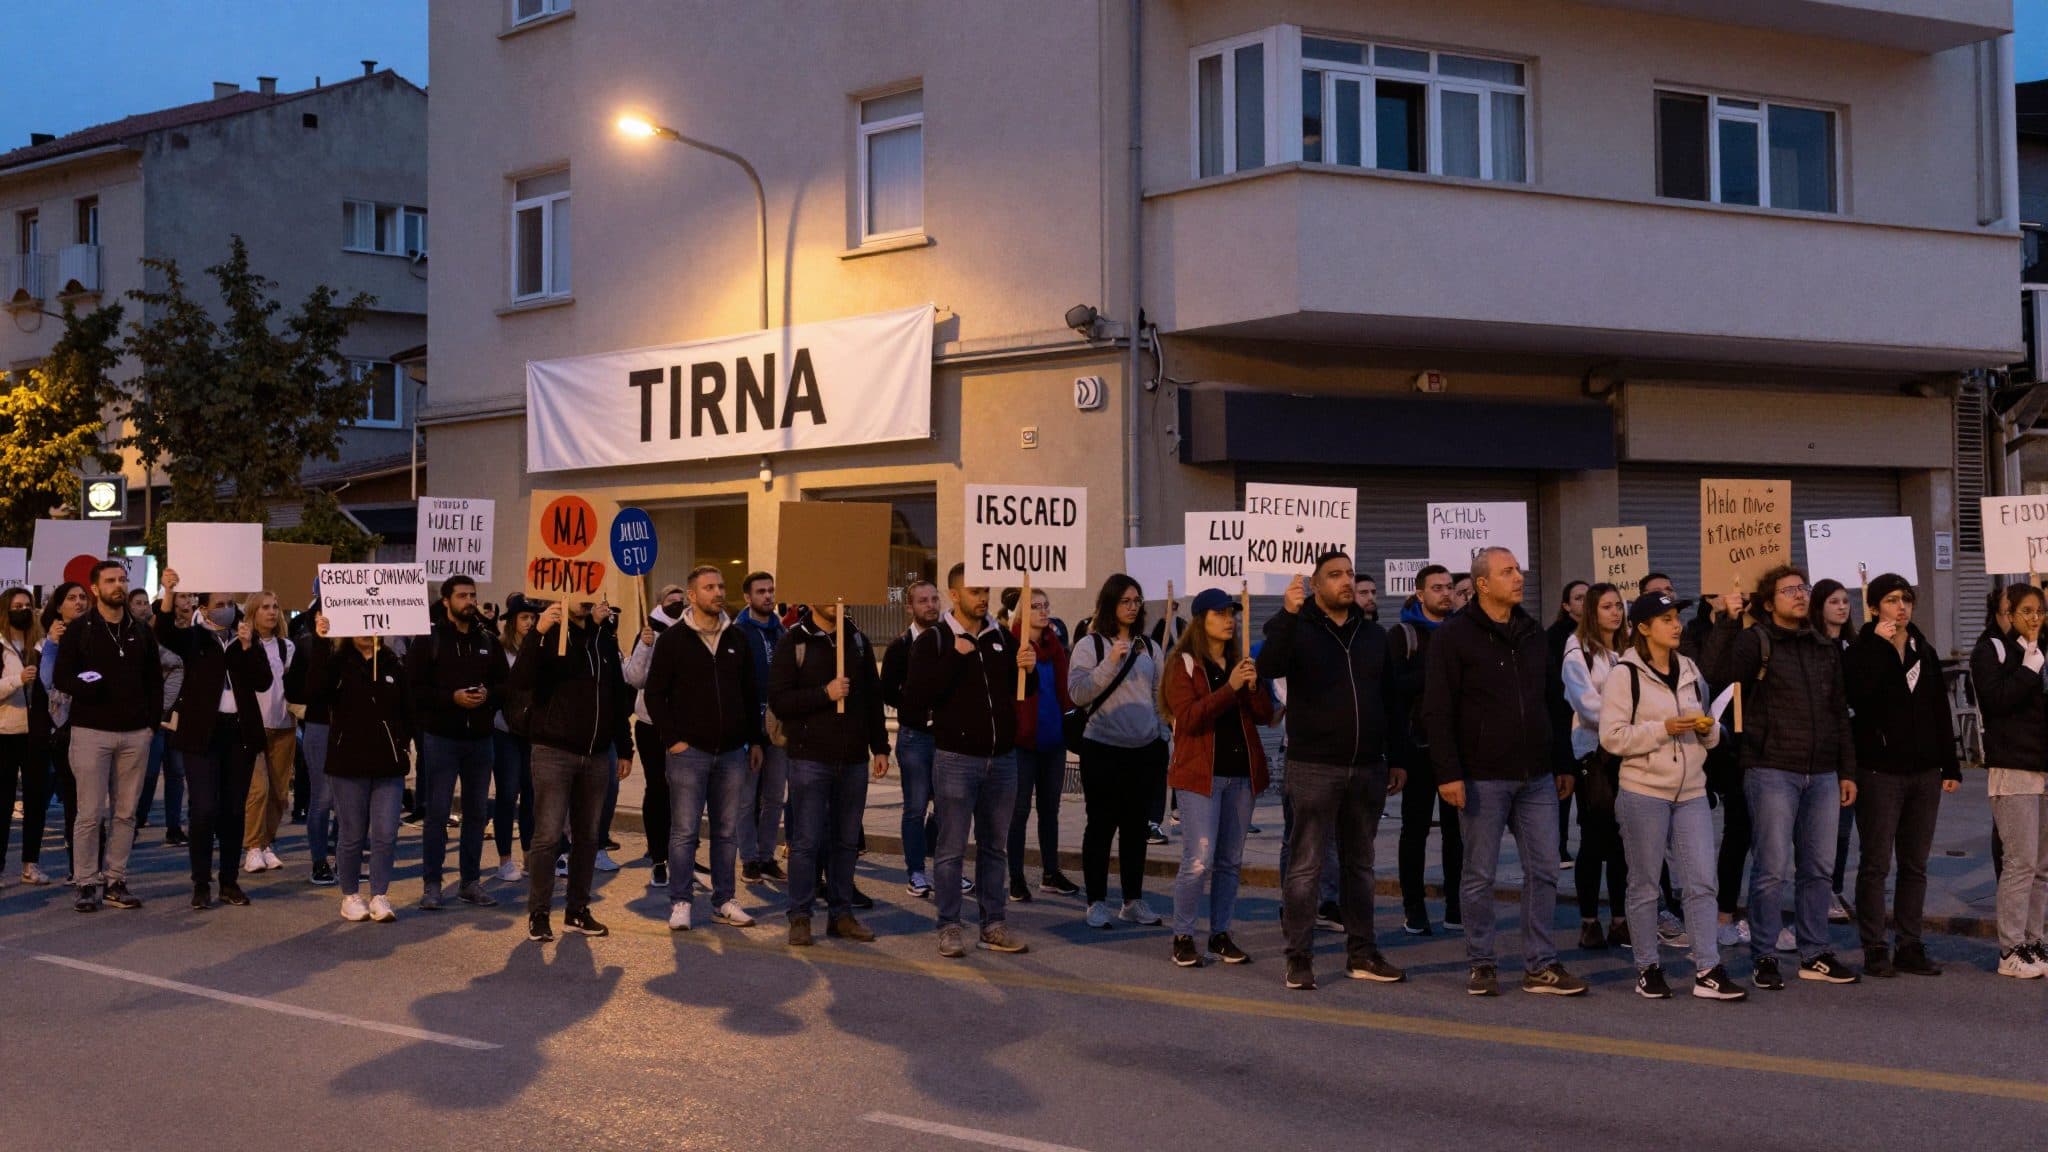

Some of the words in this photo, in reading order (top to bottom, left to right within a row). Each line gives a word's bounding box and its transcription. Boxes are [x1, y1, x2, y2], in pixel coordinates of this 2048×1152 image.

[628, 348, 827, 443] TIRNA
[554, 506, 587, 546] MA
[1809, 523, 1832, 539] ES
[982, 543, 1067, 572] ENQUIN
